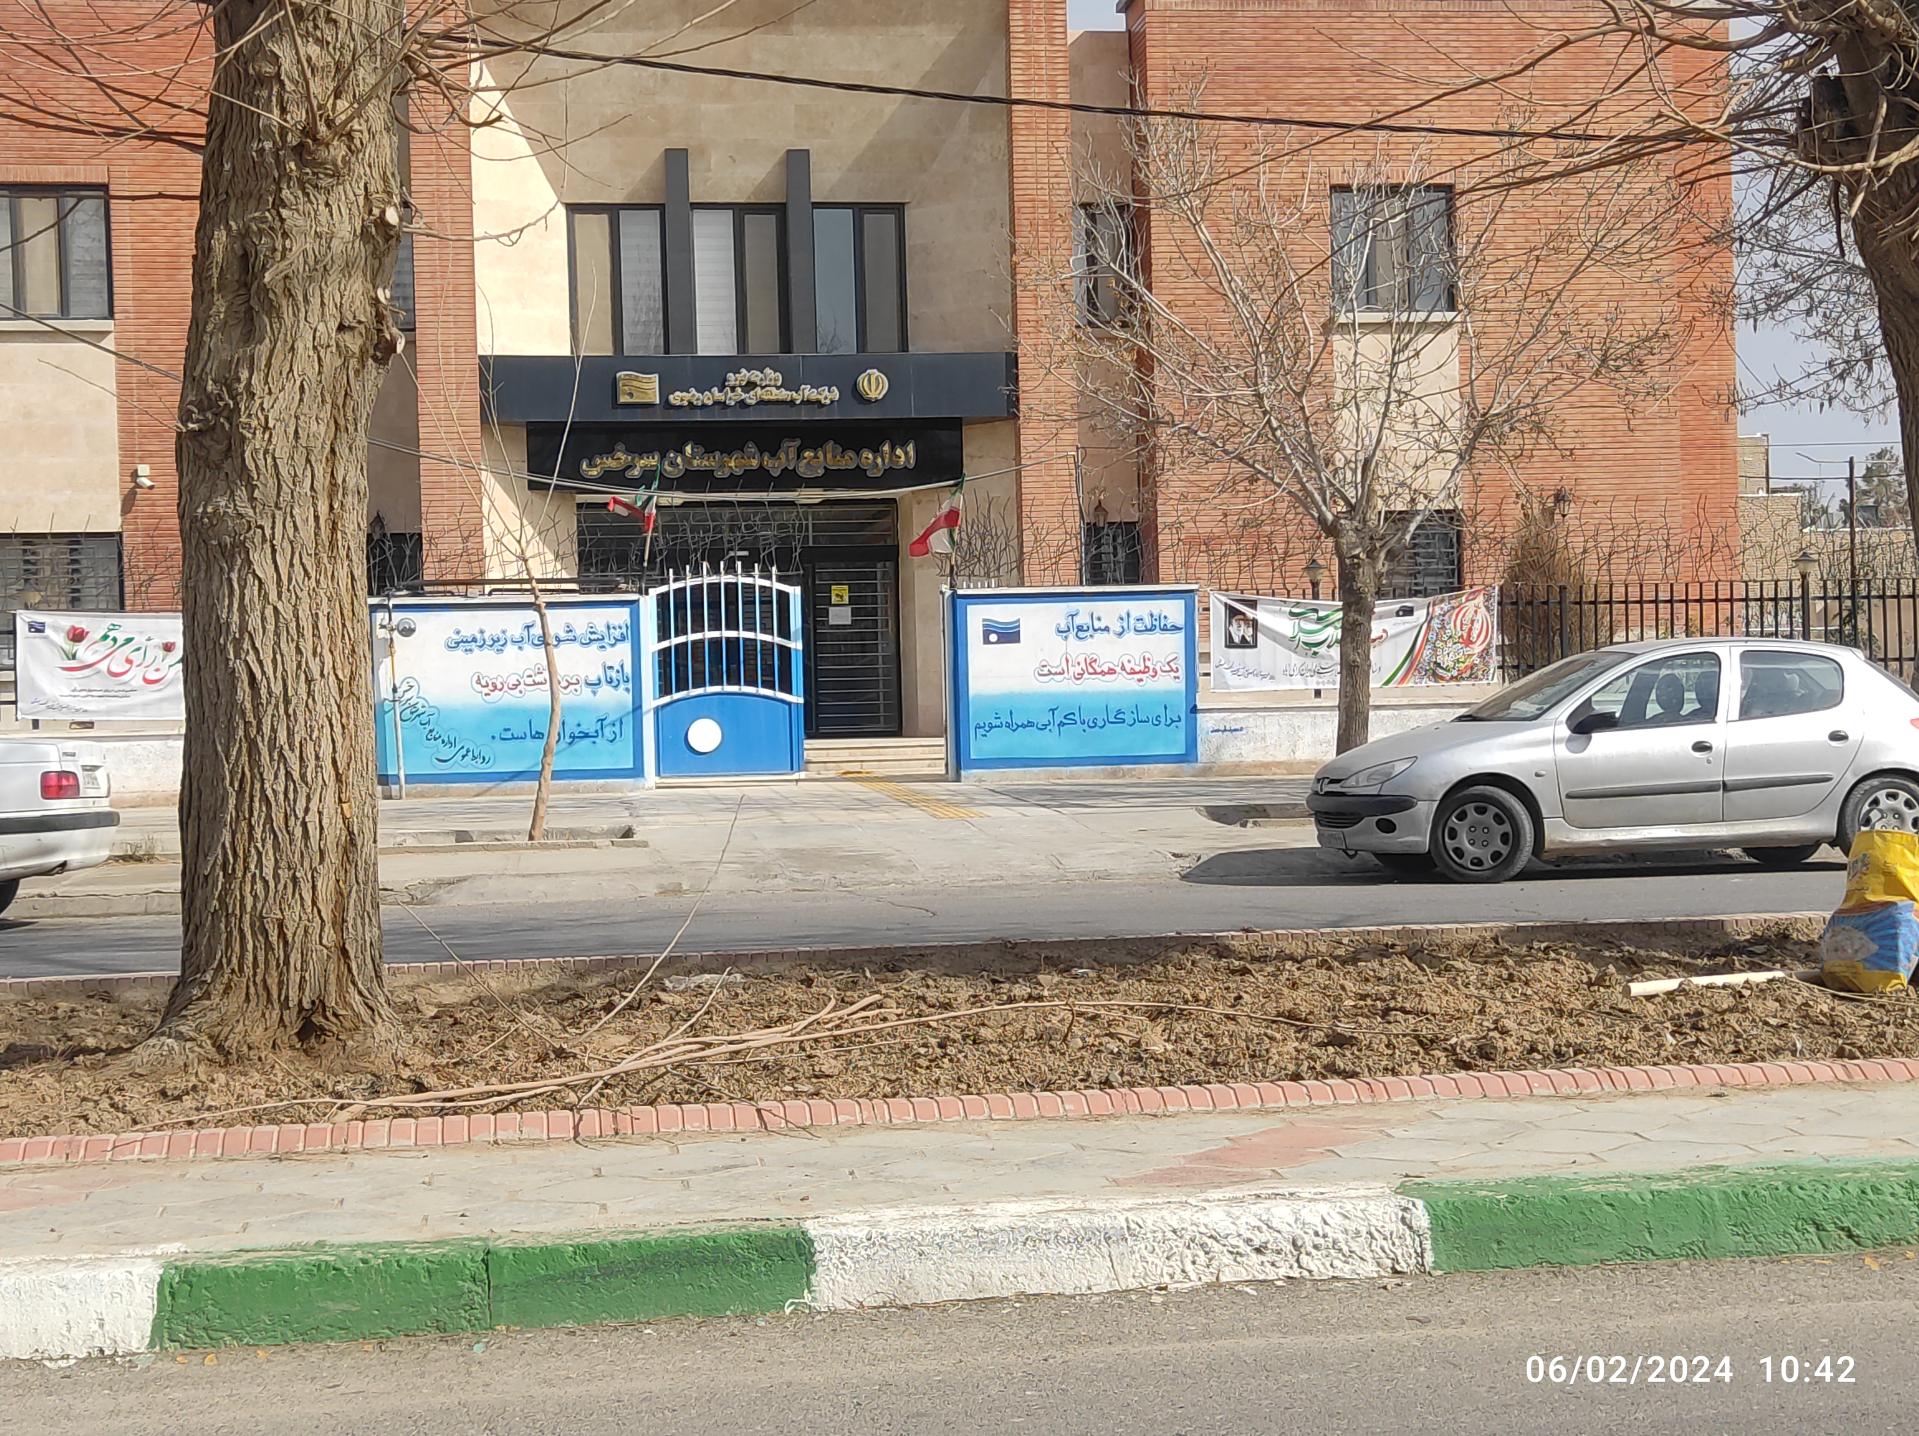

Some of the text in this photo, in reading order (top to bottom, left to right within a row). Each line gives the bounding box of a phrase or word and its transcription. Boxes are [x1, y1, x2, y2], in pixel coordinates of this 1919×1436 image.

[668, 388, 702, 405] رضوی
[703, 387, 744, 405] خراسان
[580, 438, 917, 478] اداره منابع آب شهرستان سرخس
[511, 620, 536, 650] آب
[532, 623, 577, 648] شوی
[580, 619, 630, 650] افزایش
[1056, 609, 1183, 640] حفاظت از منابع آب
[1037, 655, 1180, 682] یک وظیفه همگانی است
[476, 674, 503, 697] رویه
[507, 676, 521, 694] بی
[974, 712, 1004, 742] شویم
[1005, 710, 1035, 733] همراه
[1078, 704, 1086, 733] با
[1151, 704, 1182, 728] برای
[607, 717, 624, 743] از
